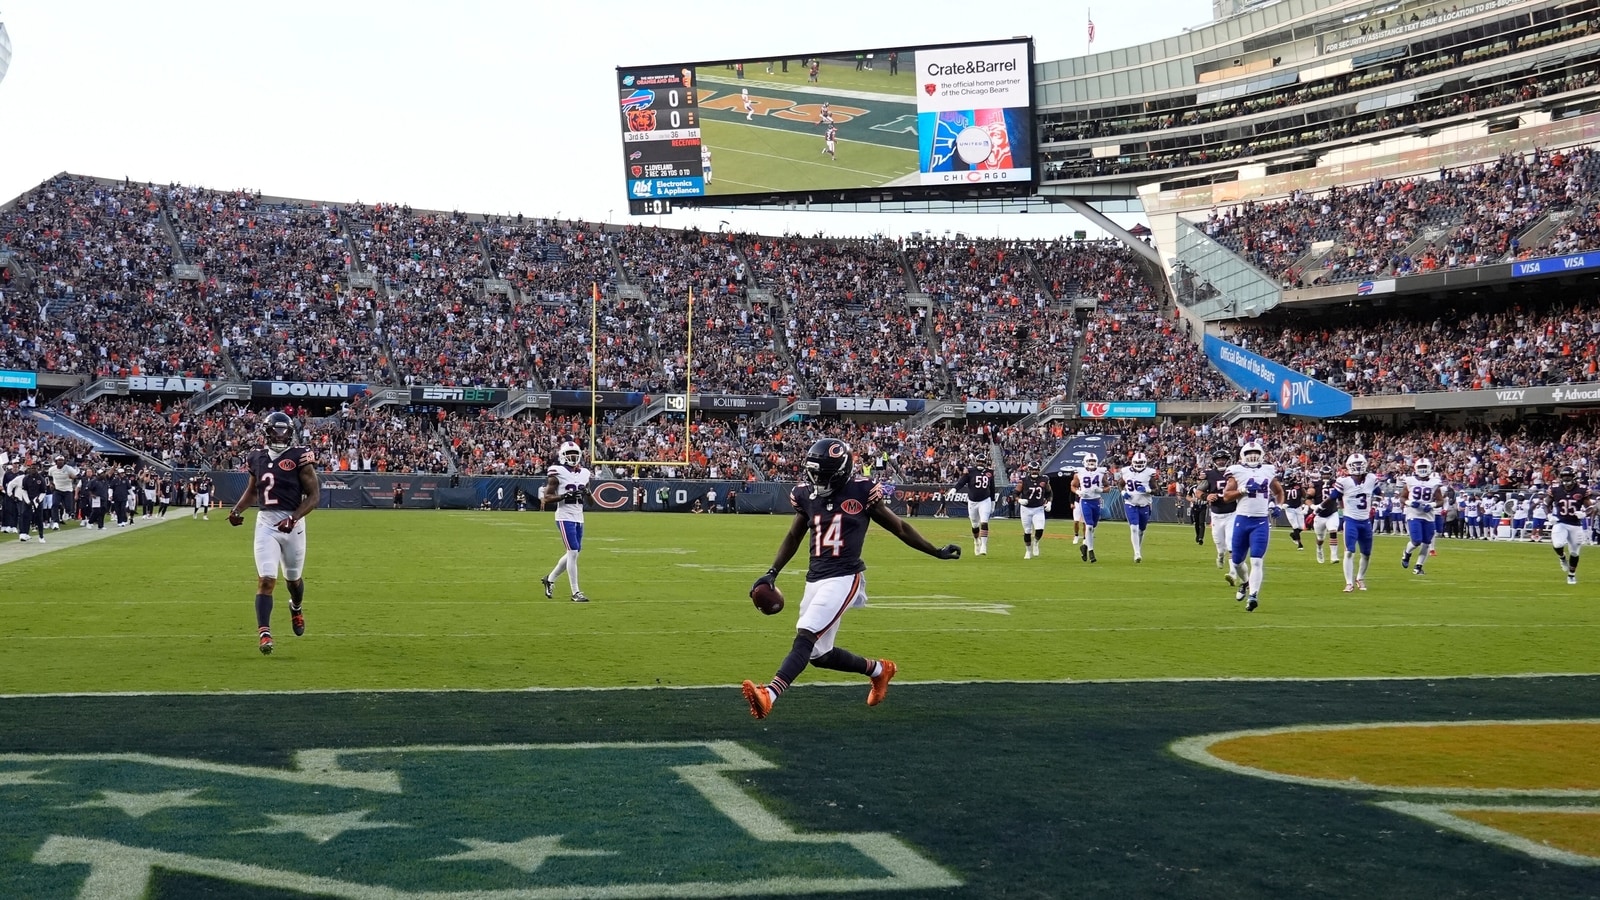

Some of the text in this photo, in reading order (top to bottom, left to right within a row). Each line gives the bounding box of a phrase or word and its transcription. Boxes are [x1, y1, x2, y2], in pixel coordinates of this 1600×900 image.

[1326, 44, 1338, 52] FOR
[1404, 21, 1419, 32] TEXT
[1420, 15, 1438, 27] ISSUE
[1443, 7, 1474, 22] LOCATION
[1475, 4, 1484, 12] TO
[928, 58, 1016, 76] Crate&Barrel
[996, 78, 1020, 87] partner
[669, 90, 679, 108] 0
[961, 88, 988, 97] Chicago
[670, 111, 680, 128] 0
[633, 180, 652, 193] Abt
[1520, 263, 1540, 274] VISA
[1563, 257, 1584, 268] VISA
[1220, 346, 1235, 363] Official
[1236, 351, 1246, 368] Bank
[1248, 358, 1253, 370] of
[1260, 364, 1275, 384] Bears
[130, 377, 206, 392] BEAR
[271, 383, 348, 397] DOWN
[423, 388, 495, 400] ESPN BET
[1291, 380, 1313, 406] PNC
[1496, 390, 1525, 400] VIZZY
[668, 398, 683, 409] 40
[714, 398, 746, 407] HOLLYWOOD
[836, 399, 907, 412] BEAR
[968, 402, 1038, 414] DOWN
[975, 476, 989, 488] 58
[1083, 475, 1100, 488] 94
[261, 472, 278, 505] 2
[1028, 486, 1042, 499] 73
[1286, 489, 1298, 500] 70
[1413, 486, 1432, 501] 98
[1356, 493, 1367, 510] 3
[1559, 499, 1577, 516] 35
[814, 513, 844, 557] 14
